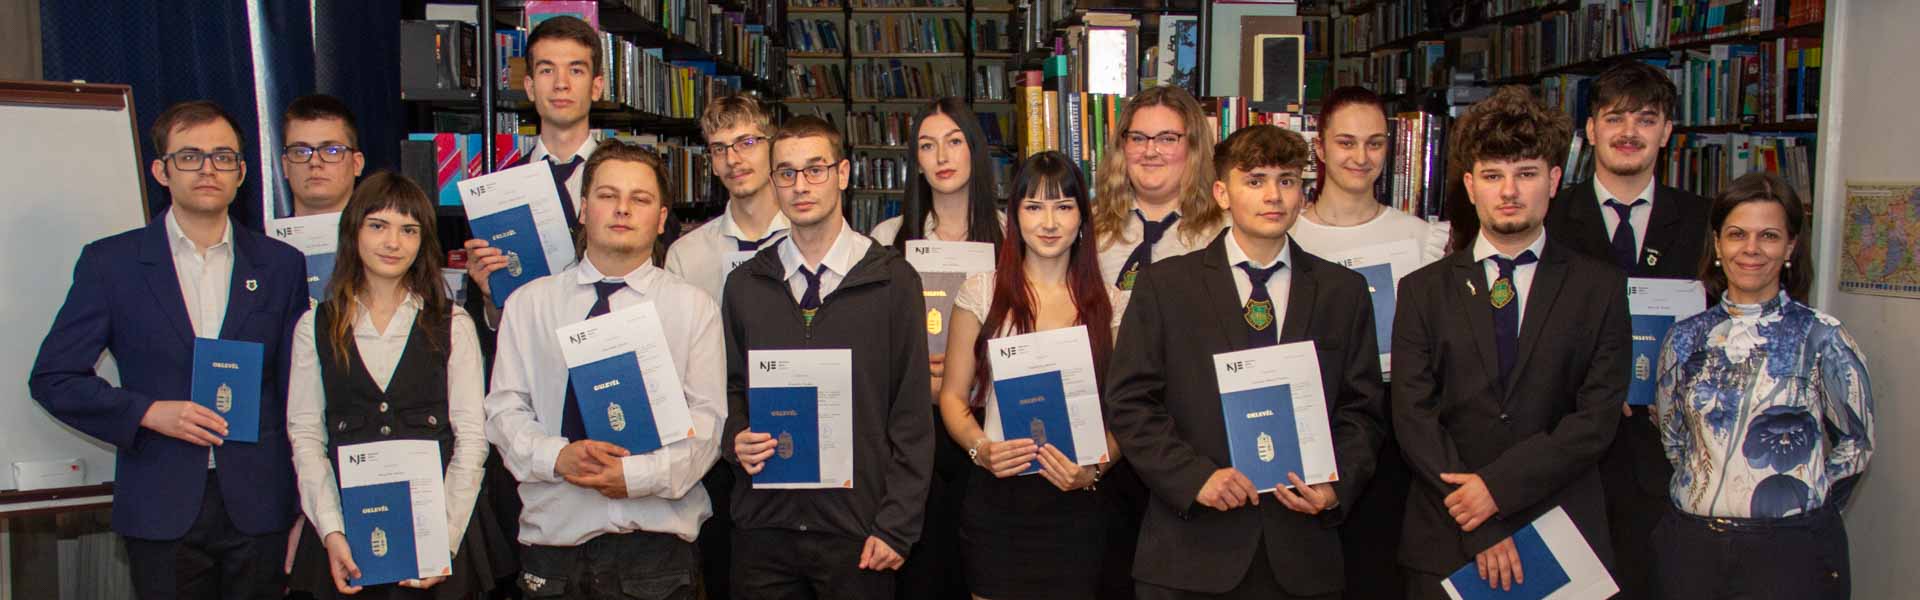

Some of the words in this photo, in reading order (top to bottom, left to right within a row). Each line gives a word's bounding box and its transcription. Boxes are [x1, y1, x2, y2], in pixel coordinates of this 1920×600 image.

[569, 331, 587, 344] NJE
[1000, 346, 1017, 358] NJE
[760, 361, 777, 372] NJE
[1226, 361, 1243, 373] NJE
[349, 453, 366, 465] NJE
